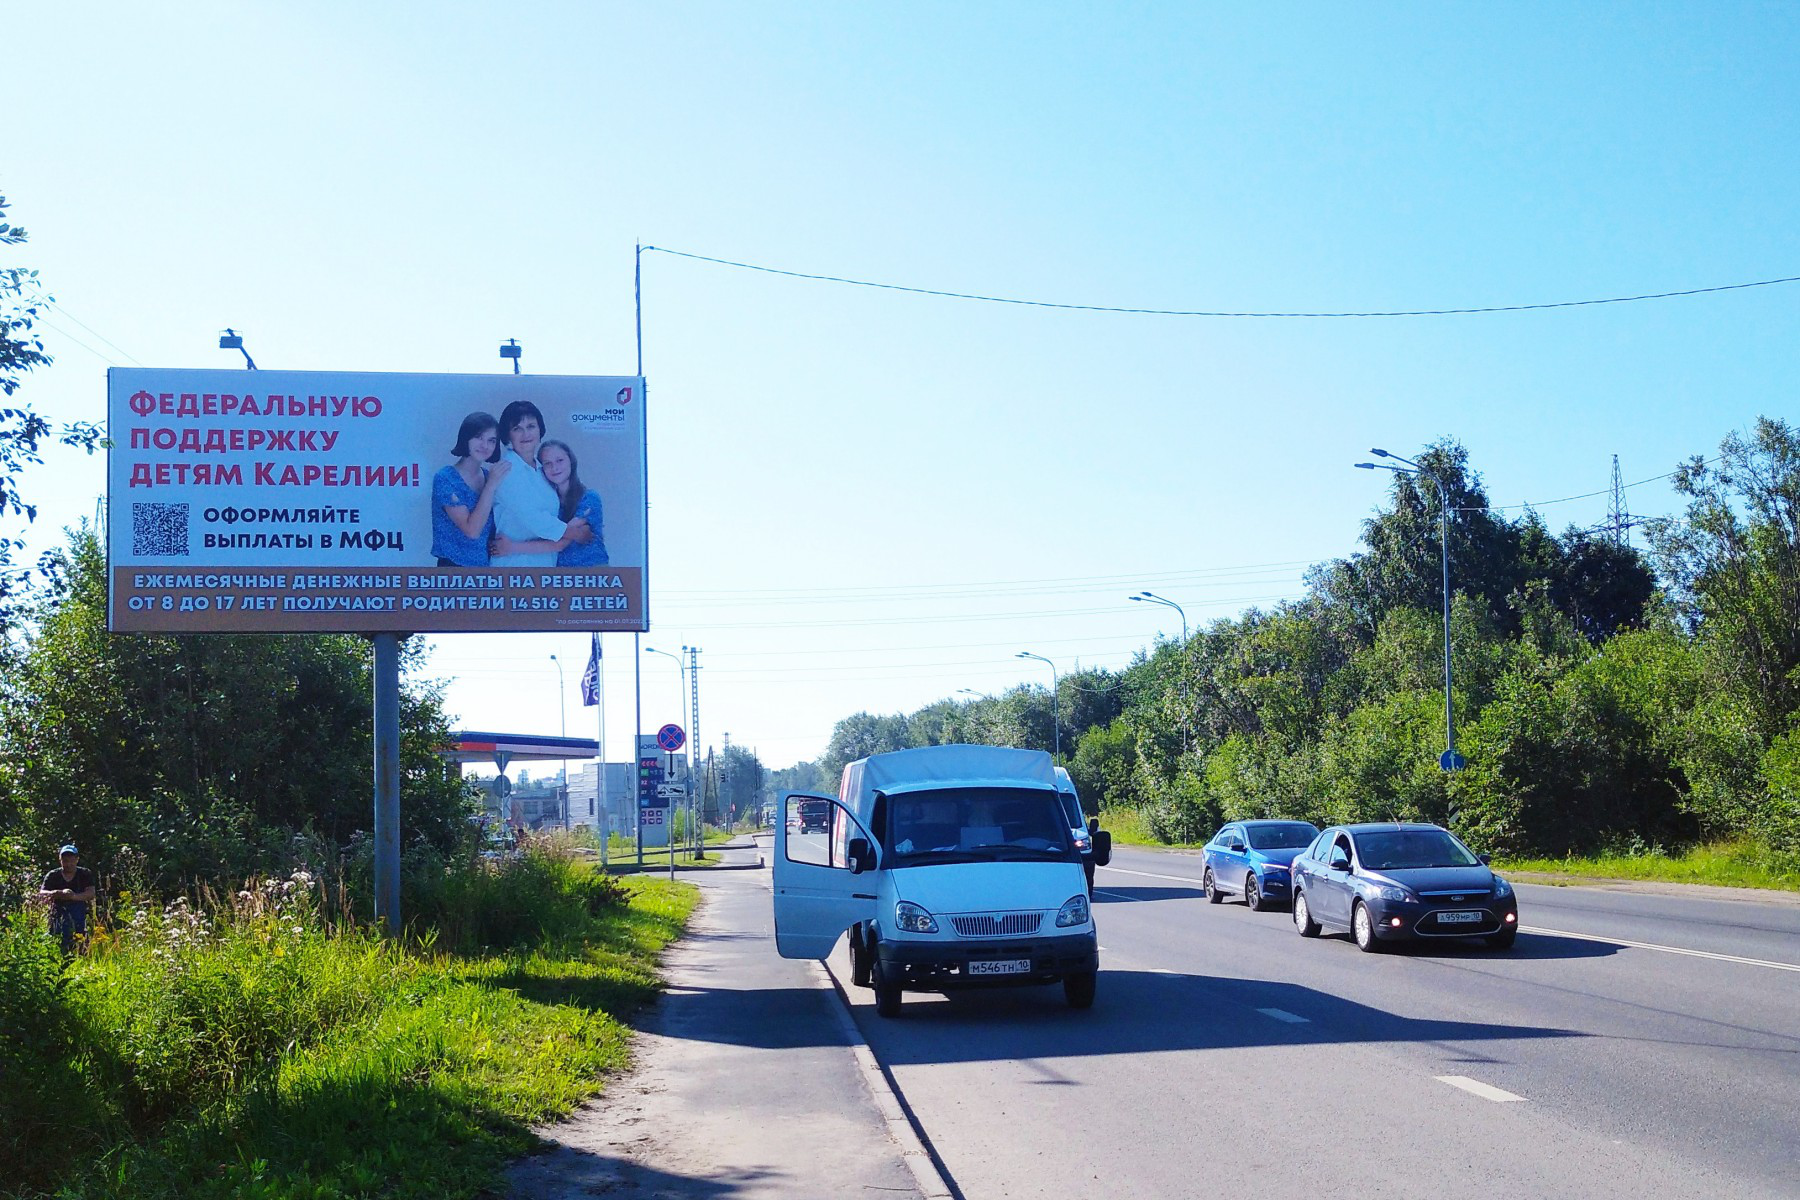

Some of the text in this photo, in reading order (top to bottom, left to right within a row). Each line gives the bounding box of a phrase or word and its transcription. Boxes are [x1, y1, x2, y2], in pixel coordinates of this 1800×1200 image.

[129, 390, 382, 418] ФЕДЕРАЛЬНУЮ
[130, 428, 340, 453] ПОДДЕРЖКУ
[129, 463, 243, 488] ДЕТЯМ
[203, 505, 360, 524] ОФОРМЛЯЙТЕ
[204, 529, 404, 551] ВЫПЛАТЫ В МФЦ
[134, 575, 623, 590] ЕЖЕМЕСЯЧНЫЕ ДЕНЕЖНЫЕ ВЫПЛАТЫ НА РЕБЕНКА
[128, 596, 155, 610] ОТ
[161, 596, 173, 610] 8
[179, 596, 209, 612] ДО
[215, 596, 236, 610] 17
[241, 597, 278, 610] ЛЕТ
[283, 596, 397, 611] ПОЛУЧАЮТ
[402, 596, 505, 611] РОДИТЕЛИ
[570, 594, 628, 612] ДЕТЕЙ
[1017, 960, 1028, 969] 10
